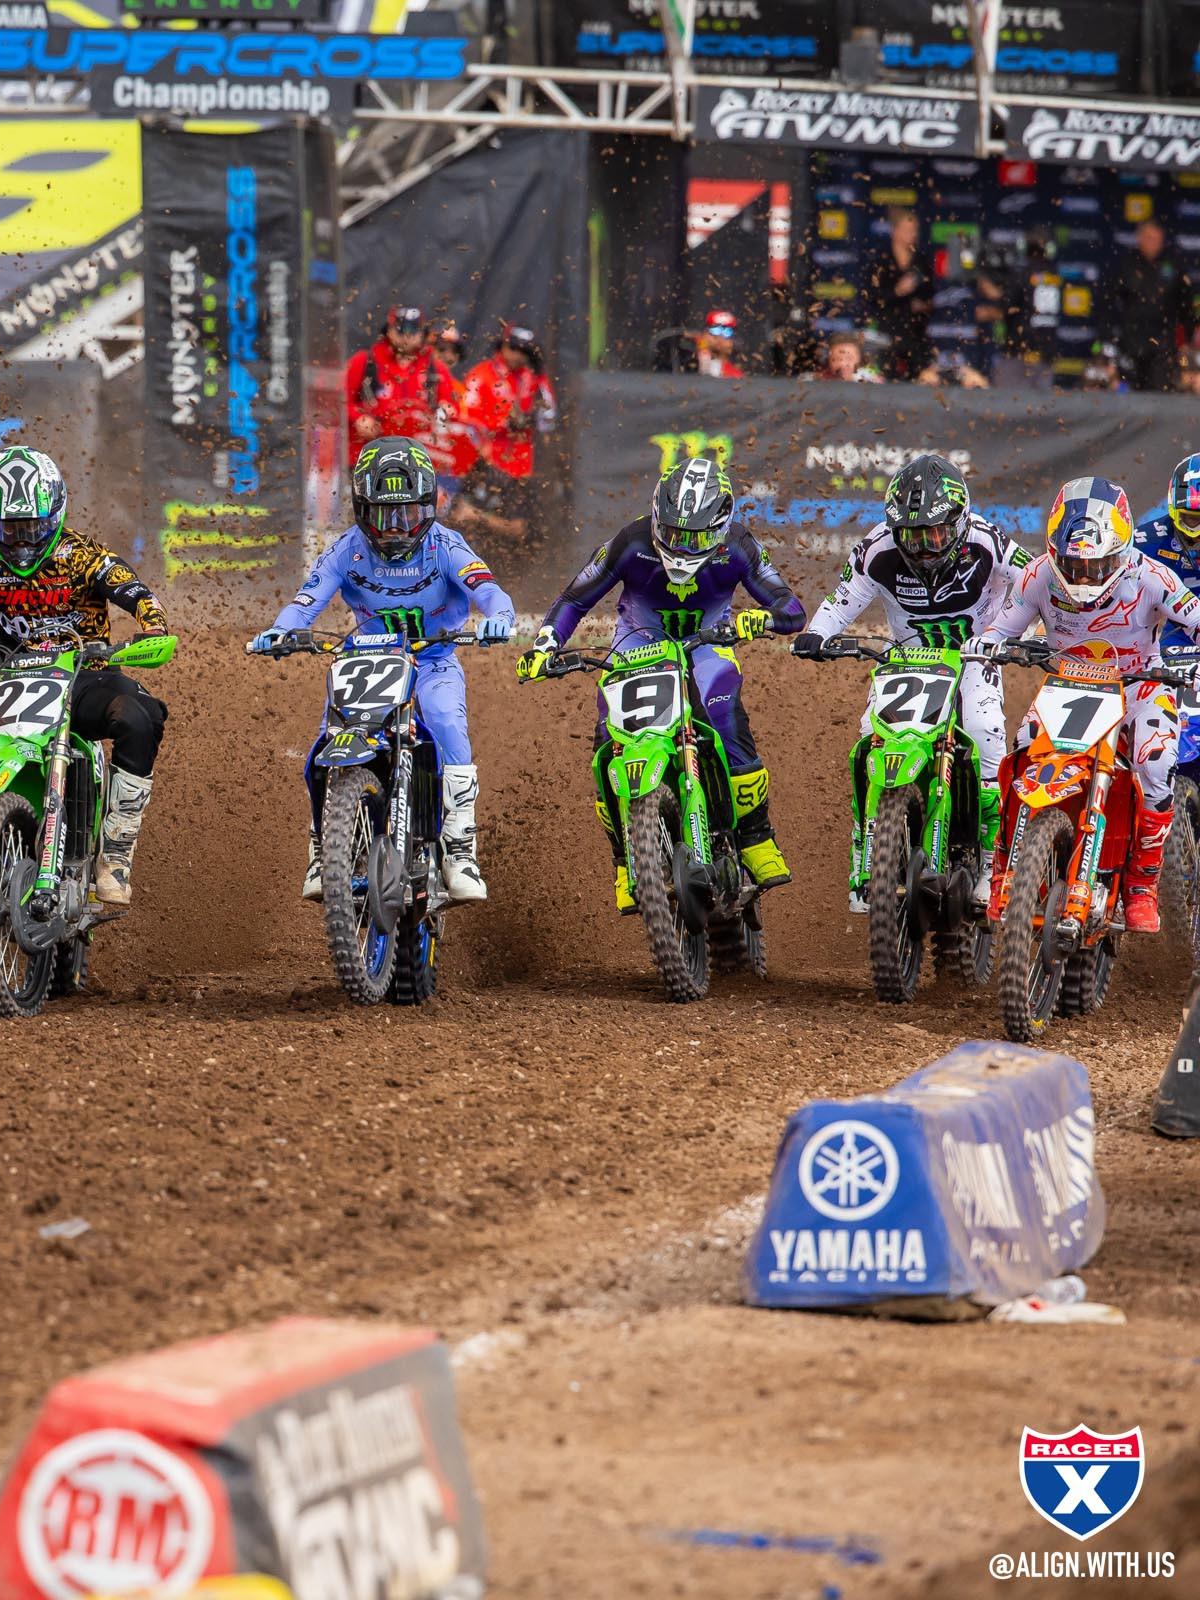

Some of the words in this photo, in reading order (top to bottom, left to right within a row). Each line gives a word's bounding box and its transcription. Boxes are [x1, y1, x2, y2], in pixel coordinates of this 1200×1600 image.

[113, 76, 330, 113] Championship
[753, 89, 825, 115] ROCKY
[831, 93, 960, 121] MOUNTAIN
[1064, 108, 1142, 134] ROCKY
[167, 246, 201, 424] MONSTER
[383, 567, 420, 577] YAMAHA
[898, 588, 926, 596] AIROH
[893, 653, 943, 661] RENTHAL
[1063, 669, 1113, 681] RENTHAL
[1064, 662, 1114, 674] RENTHAL
[334, 658, 405, 706] 32
[622, 674, 676, 732] 9
[878, 676, 952, 725] 21
[1057, 695, 1104, 740] 1
[396, 788, 408, 853] DUNLOP
[932, 820, 940, 855] CARRILLO
[56, 822, 68, 871] MAXXIS
[769, 1229, 927, 1270] YAMAHA
[769, 1271, 927, 1283] RACING
